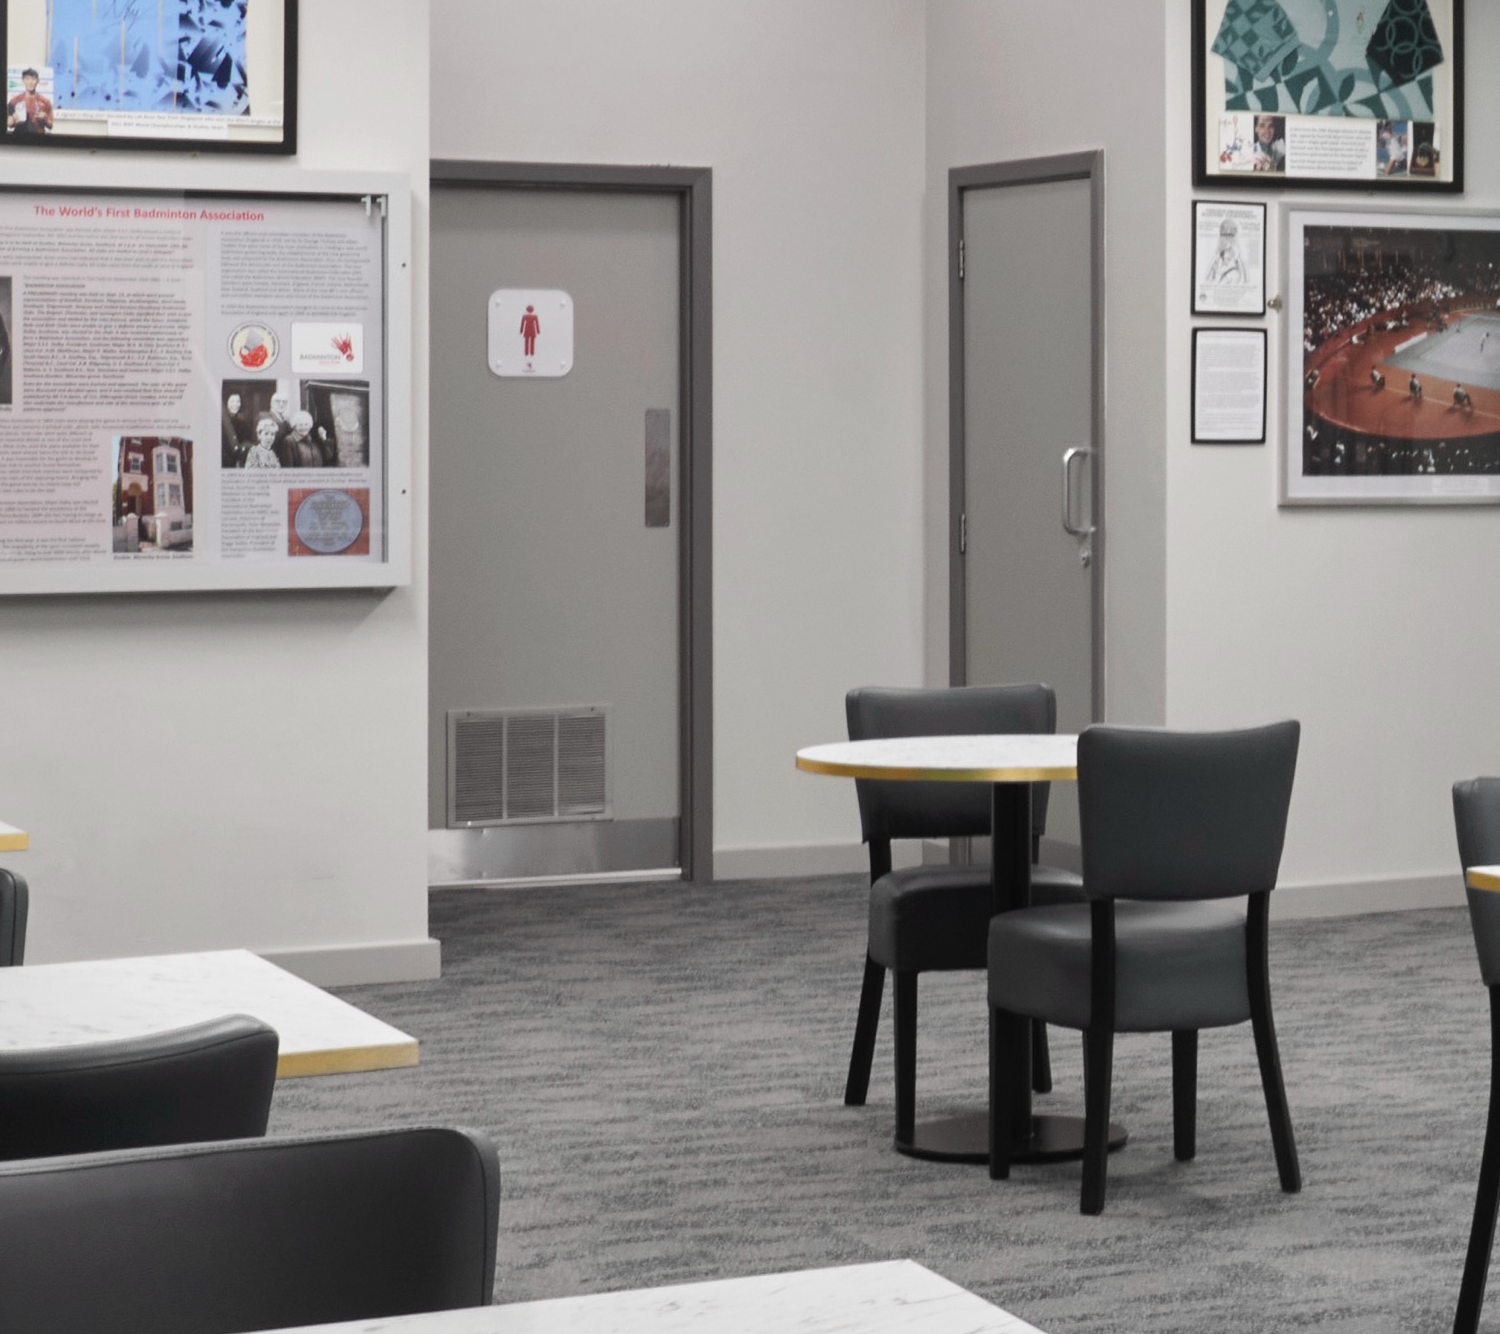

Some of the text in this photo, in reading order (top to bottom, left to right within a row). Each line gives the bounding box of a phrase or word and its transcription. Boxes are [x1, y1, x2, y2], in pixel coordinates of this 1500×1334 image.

[34, 205, 265, 222] The World's First Badminton Association
[360, 194, 387, 217] 11
